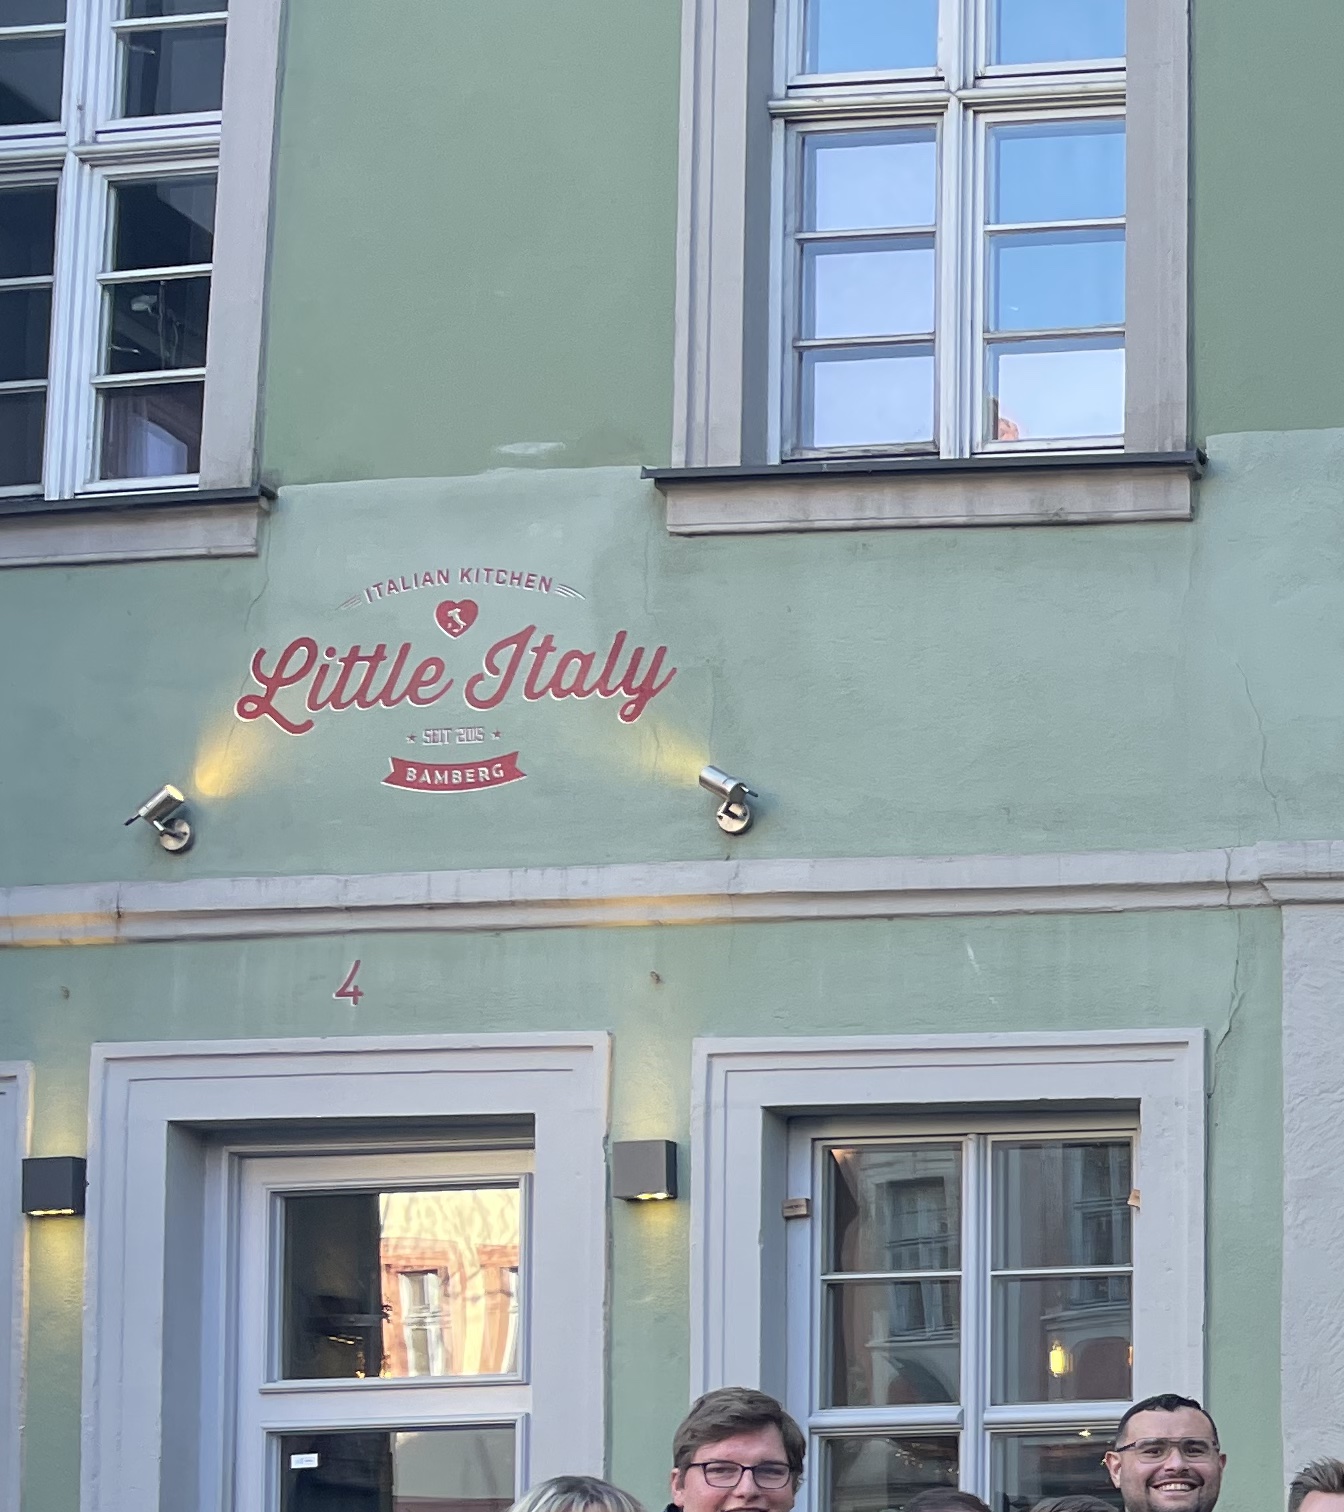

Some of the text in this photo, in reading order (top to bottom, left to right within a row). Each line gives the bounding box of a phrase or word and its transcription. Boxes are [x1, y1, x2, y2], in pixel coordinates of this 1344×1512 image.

[364, 567, 552, 604] ITALIAN KITCHEN
[235, 624, 677, 735] Little Italy
[405, 763, 504, 785] BAMBERG
[332, 959, 365, 1007] 4
